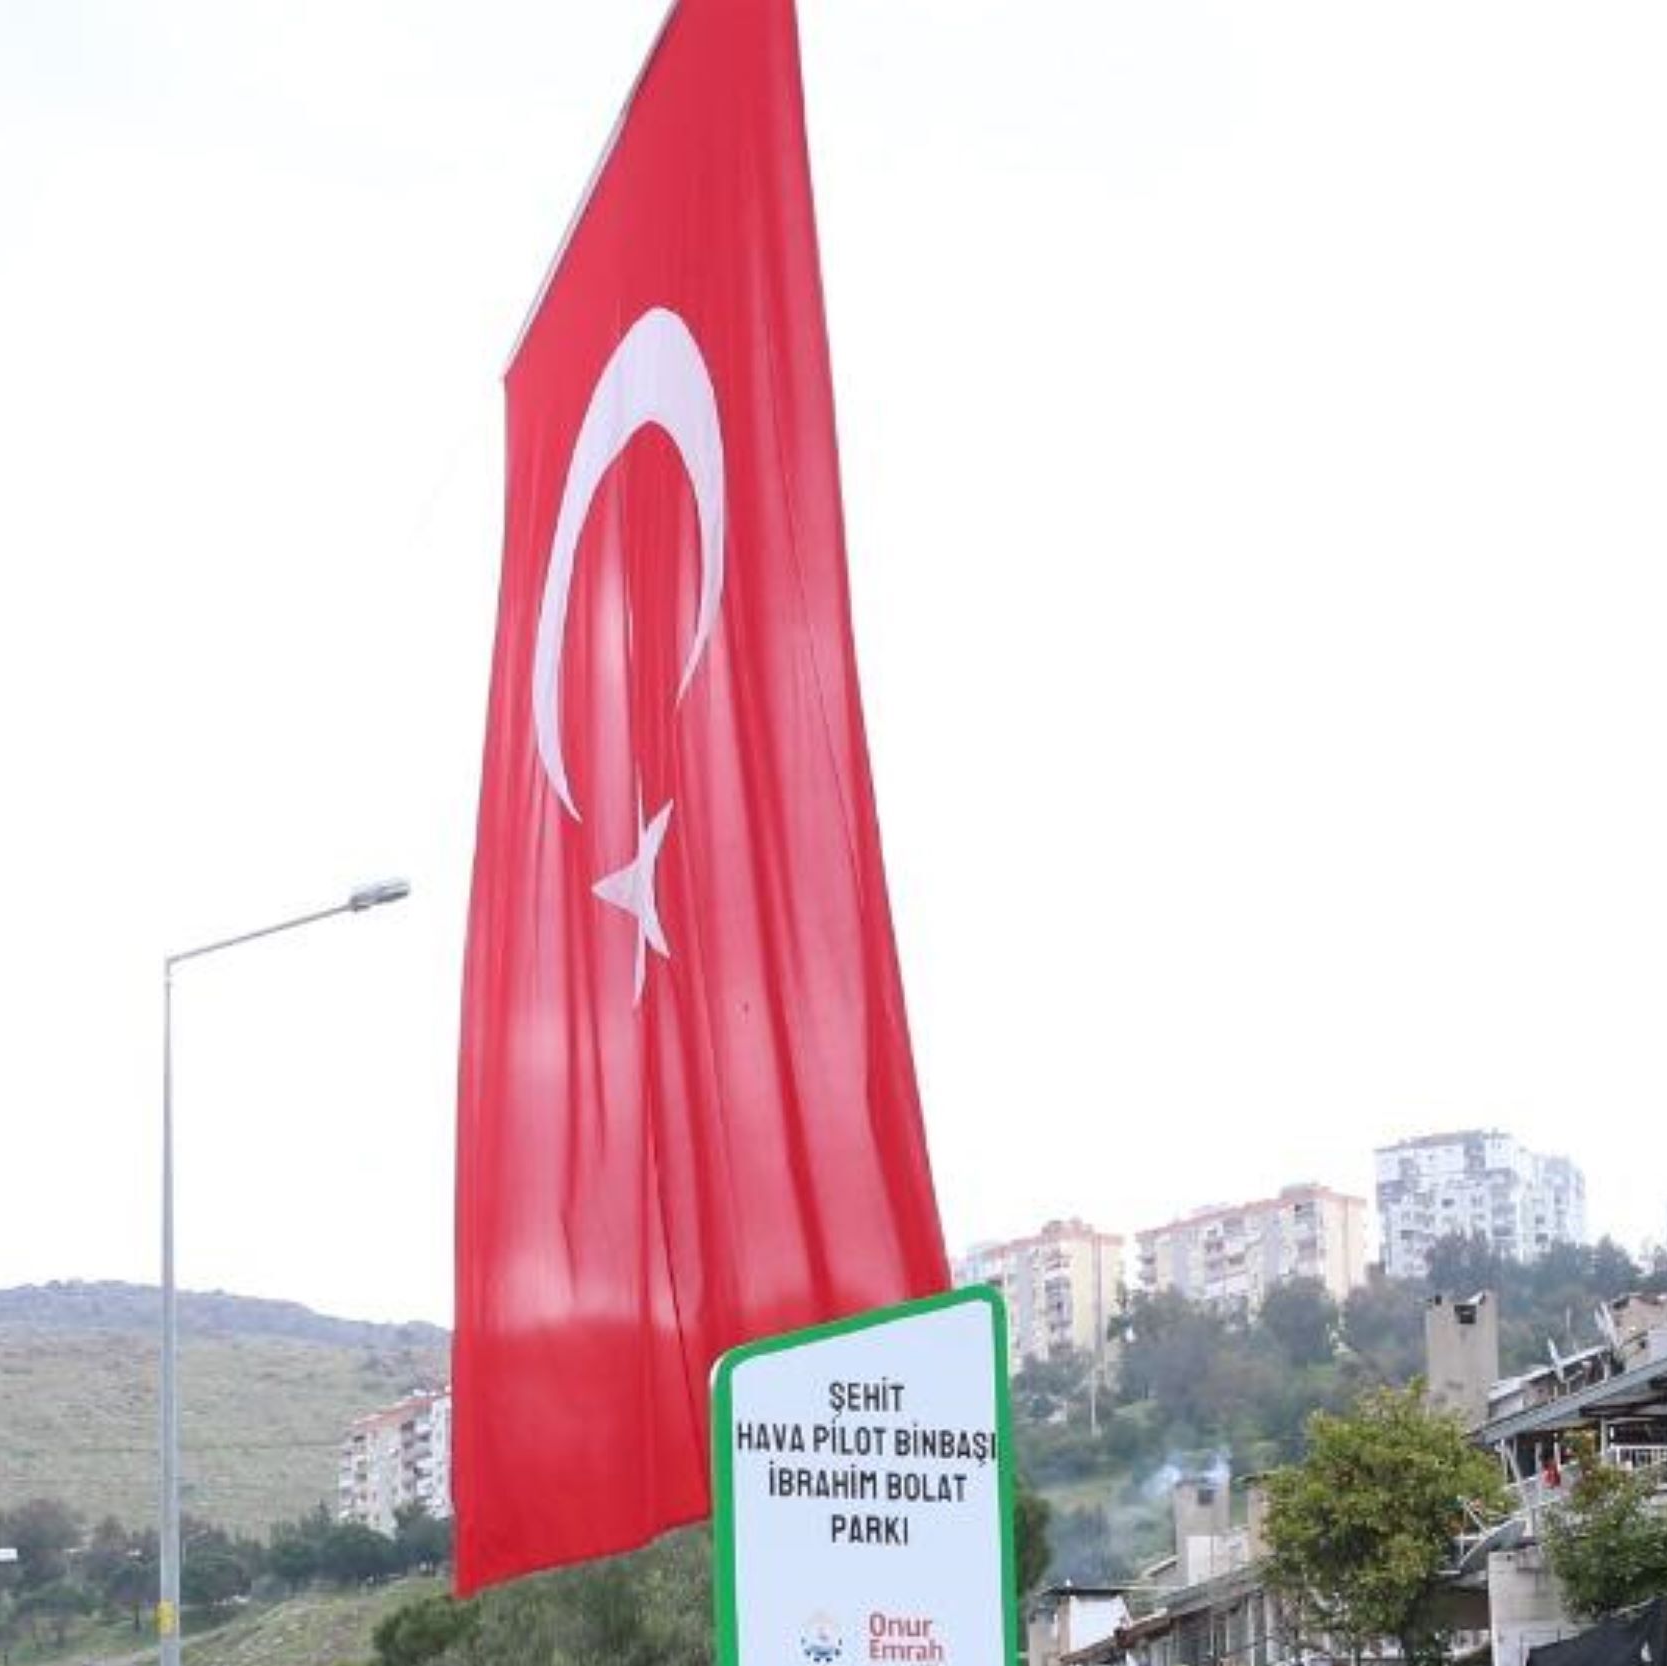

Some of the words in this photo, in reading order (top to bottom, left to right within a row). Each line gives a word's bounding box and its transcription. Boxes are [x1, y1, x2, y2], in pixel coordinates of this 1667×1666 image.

[829, 1376, 905, 1417] ŞEHİT
[737, 1421, 805, 1453] HAVA
[813, 1417, 886, 1456] PİLOT
[894, 1422, 996, 1467] BİNBAŞI
[769, 1461, 877, 1499] İBRAHİM
[887, 1473, 967, 1502] BOLAT
[831, 1514, 908, 1545] PARKI
[869, 1612, 933, 1637] Onur
[869, 1639, 943, 1661] Emrah
